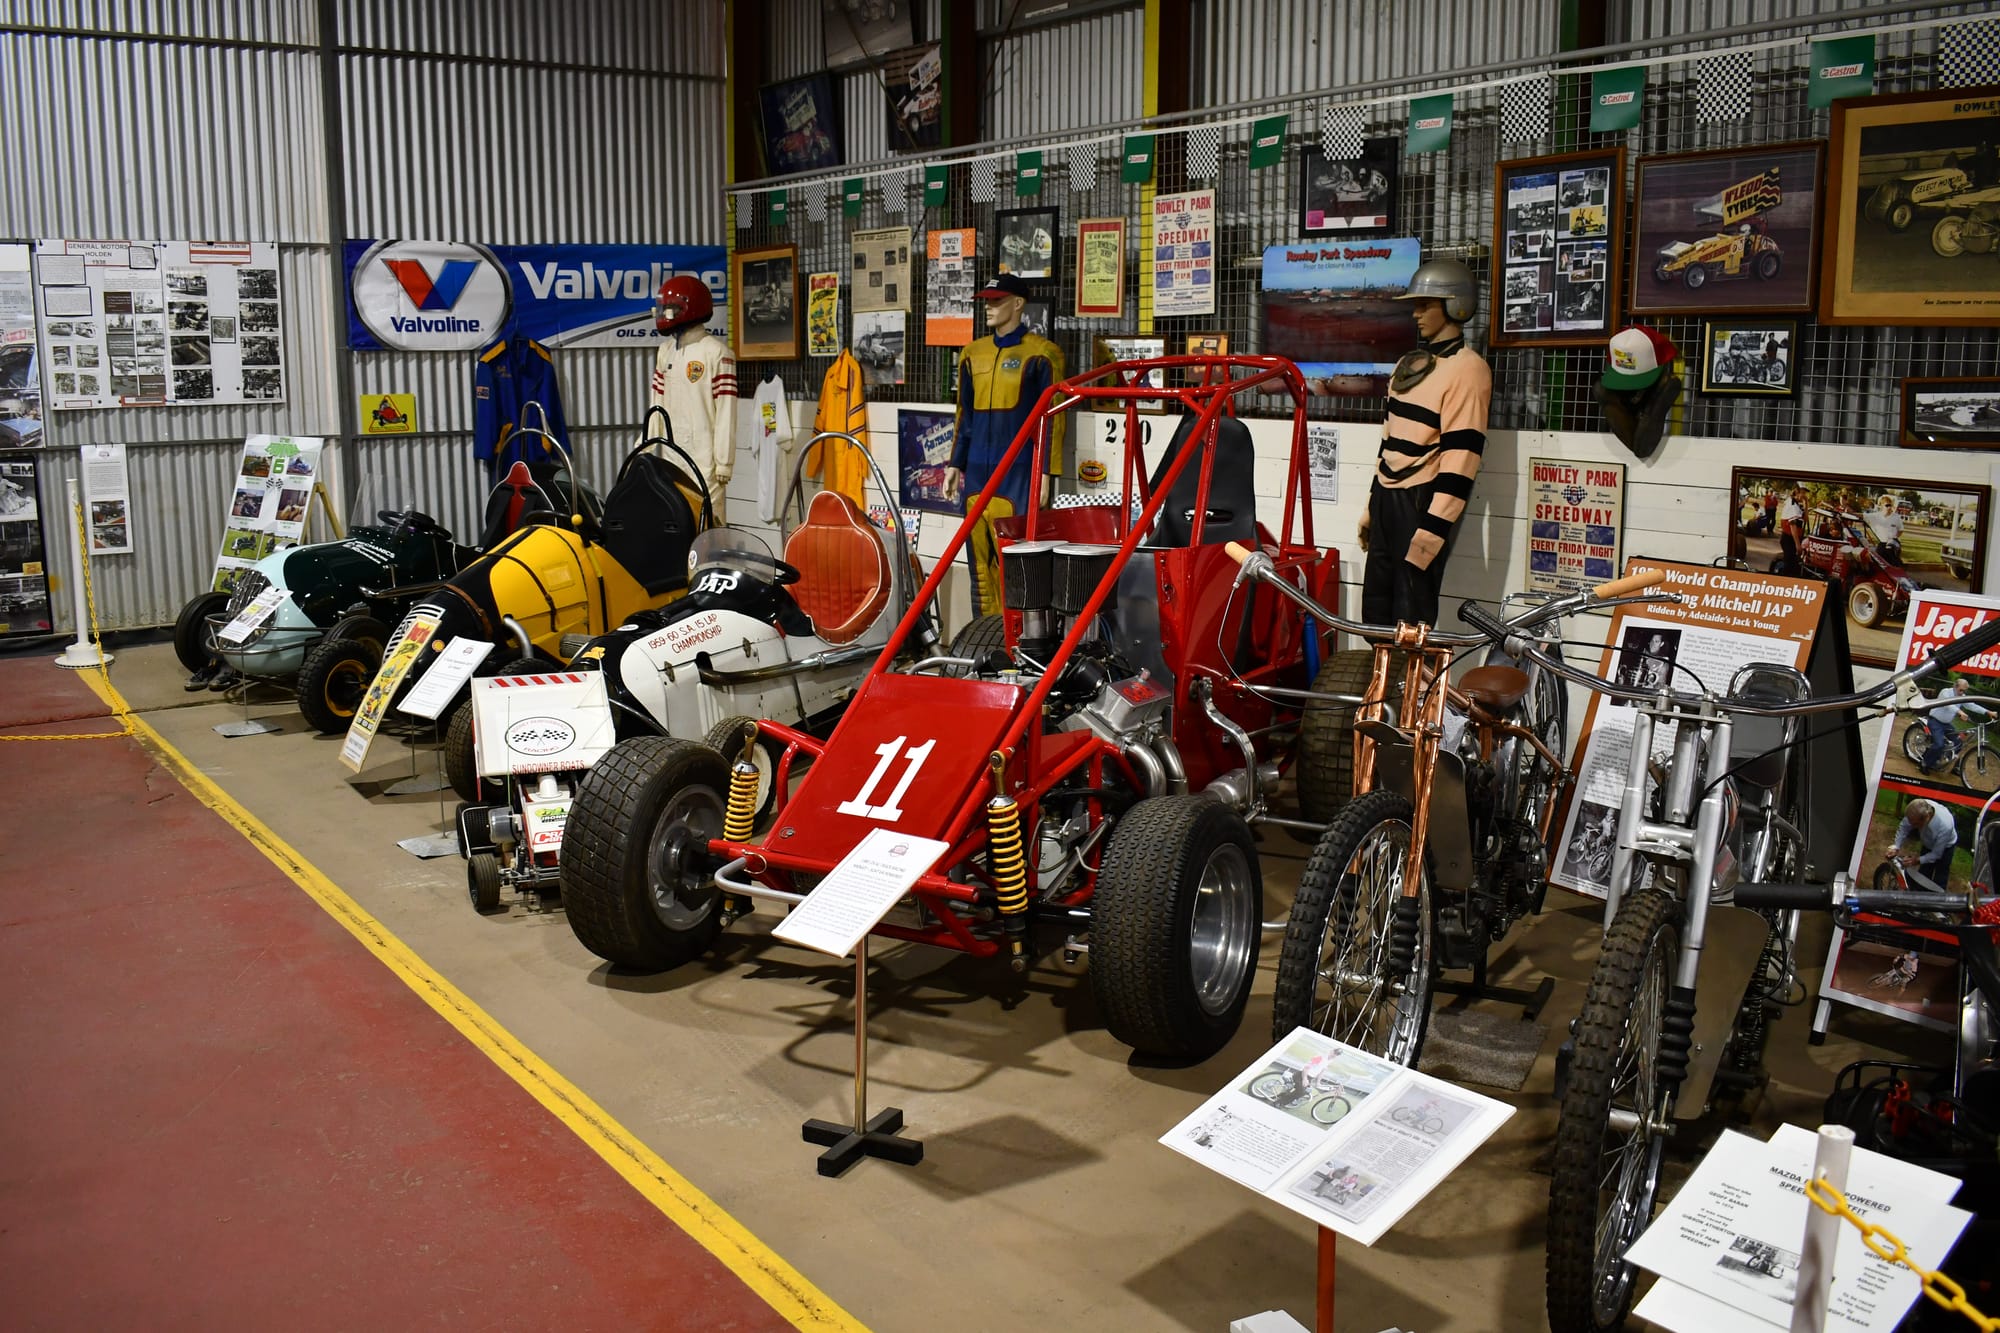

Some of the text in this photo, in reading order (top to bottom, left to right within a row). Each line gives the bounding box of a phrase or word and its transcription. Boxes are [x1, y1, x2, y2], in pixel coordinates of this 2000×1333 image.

[1829, 65, 1858, 77] Castrol
[1607, 94, 1632, 103] Castrol
[1421, 118, 1442, 128] Castrol
[1156, 196, 1211, 215] ROWLEY PARK
[1158, 228, 1209, 246] SPEEDWAY
[1286, 246, 1392, 263] Rowley Park Speedway
[518, 261, 728, 299] Valvole
[390, 316, 480, 333] Valvoline
[616, 328, 646, 338] OILS
[1105, 418, 1152, 446] 20
[272, 459, 285, 475] 6
[1533, 465, 1617, 488] ROWLEY PARK
[1536, 504, 1613, 526] SPEEDWAY
[1531, 539, 1615, 559] EVERY FRIDAY NIGHT
[1559, 557, 1566, 565] AT
[1665, 569, 1707, 588] World
[1709, 575, 1817, 605] Championship
[1701, 593, 1761, 614] Mitchell
[1762, 603, 1793, 619] JAP
[1647, 604, 1781, 633] Ridden by Adelaide's Jack Young
[648, 630, 679, 650] 1959-60
[695, 618, 705, 629] 15
[703, 613, 718, 626] LAP
[672, 624, 722, 654] CHAMPIONSHIP
[512, 759, 585, 775] SUNDOWNER BOATS
[836, 735, 937, 822] 11
[1708, 1190, 1728, 1200] GEOFF
[1769, 1166, 1892, 1213] MAZDA POWERED
[1779, 1180, 1868, 1217] SPEE TFIT
[1680, 1226, 1721, 1244] ROWLEY PARK
[1705, 1222, 1736, 1237] ATHERTON
[1680, 1233, 1712, 1248] SPEEDWAY
